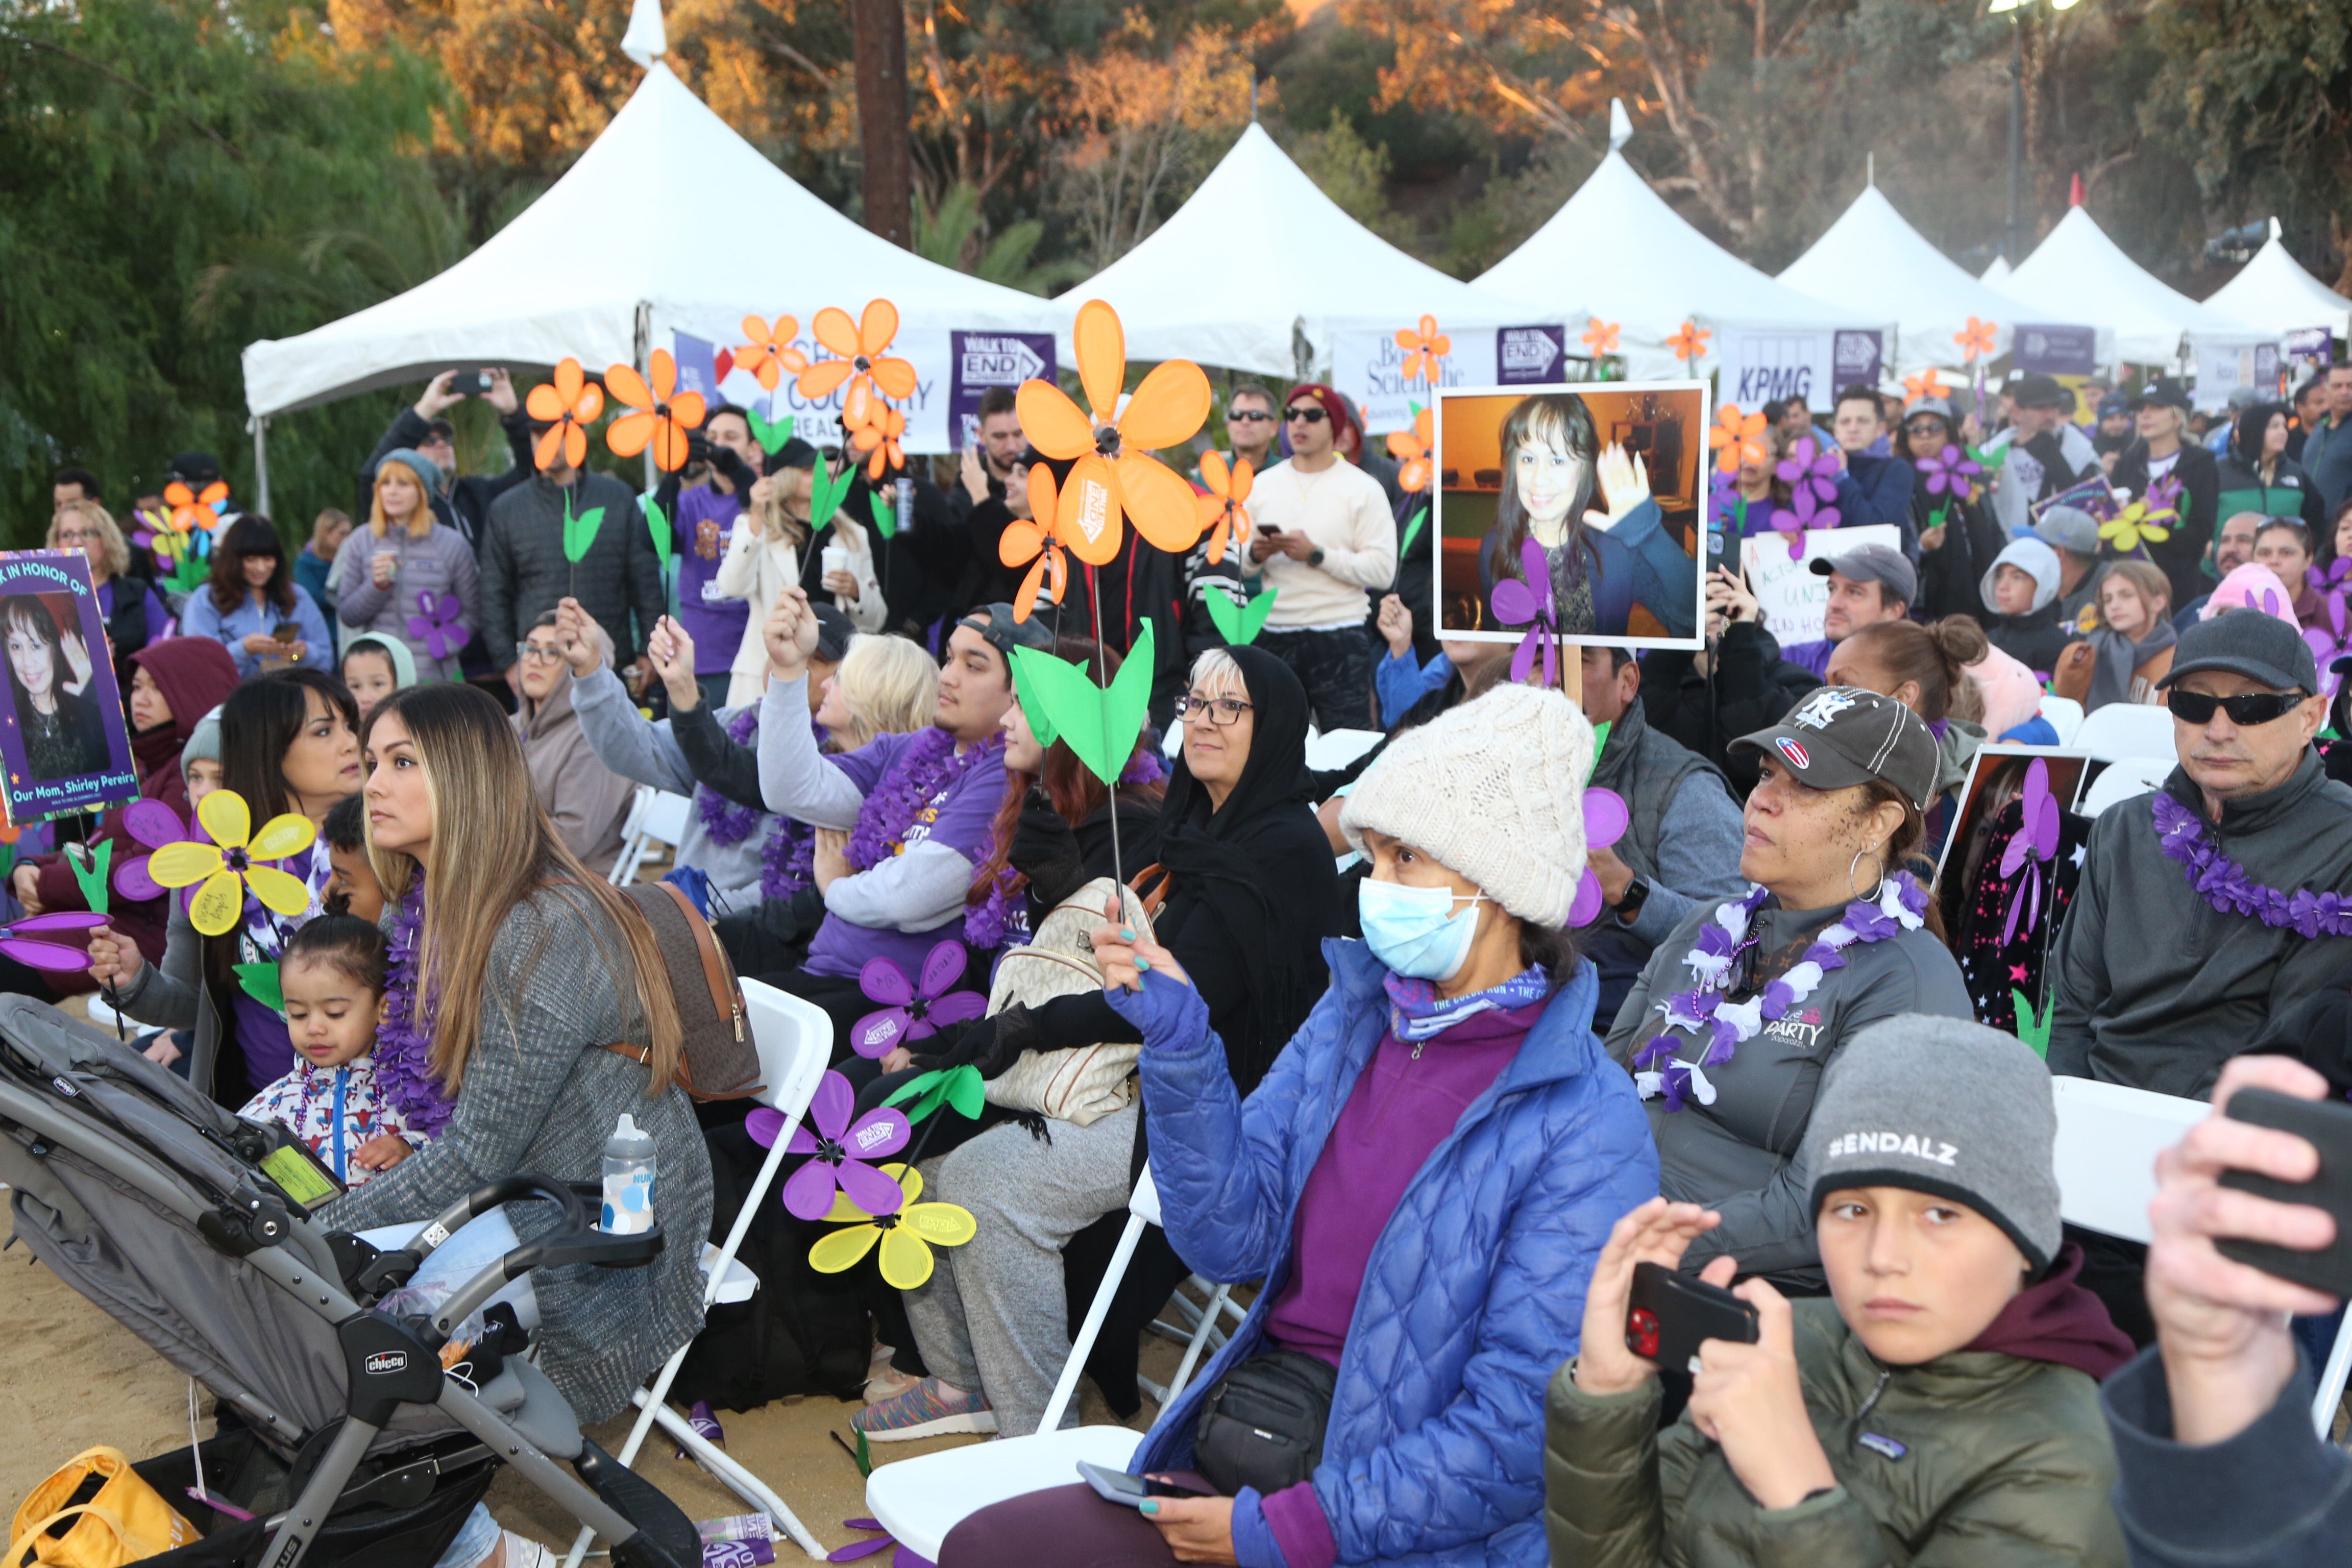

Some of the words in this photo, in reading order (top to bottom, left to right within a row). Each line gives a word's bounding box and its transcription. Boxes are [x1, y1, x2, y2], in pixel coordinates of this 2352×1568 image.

[968, 358, 1016, 372] END
[1737, 365, 1811, 402] KPMG
[1090, 484, 1099, 522] END
[6, 564, 21, 579] IN
[21, 562, 68, 585] HONOR
[70, 578, 88, 596] OF
[13, 790, 34, 803] Our
[35, 786, 64, 799] Mom,
[65, 778, 100, 794] Shirley
[101, 771, 135, 788] Pereira
[1518, 986, 1534, 999] THE
[1763, 1020, 1824, 1046] PARTY
[855, 1126, 871, 1138] WALK
[871, 1122, 880, 1131] TO
[860, 1130, 882, 1144] END
[1829, 1132, 1958, 1166] #ENDALZ
[633, 1172, 652, 1183] NUK
[369, 1354, 404, 1371] chicco
